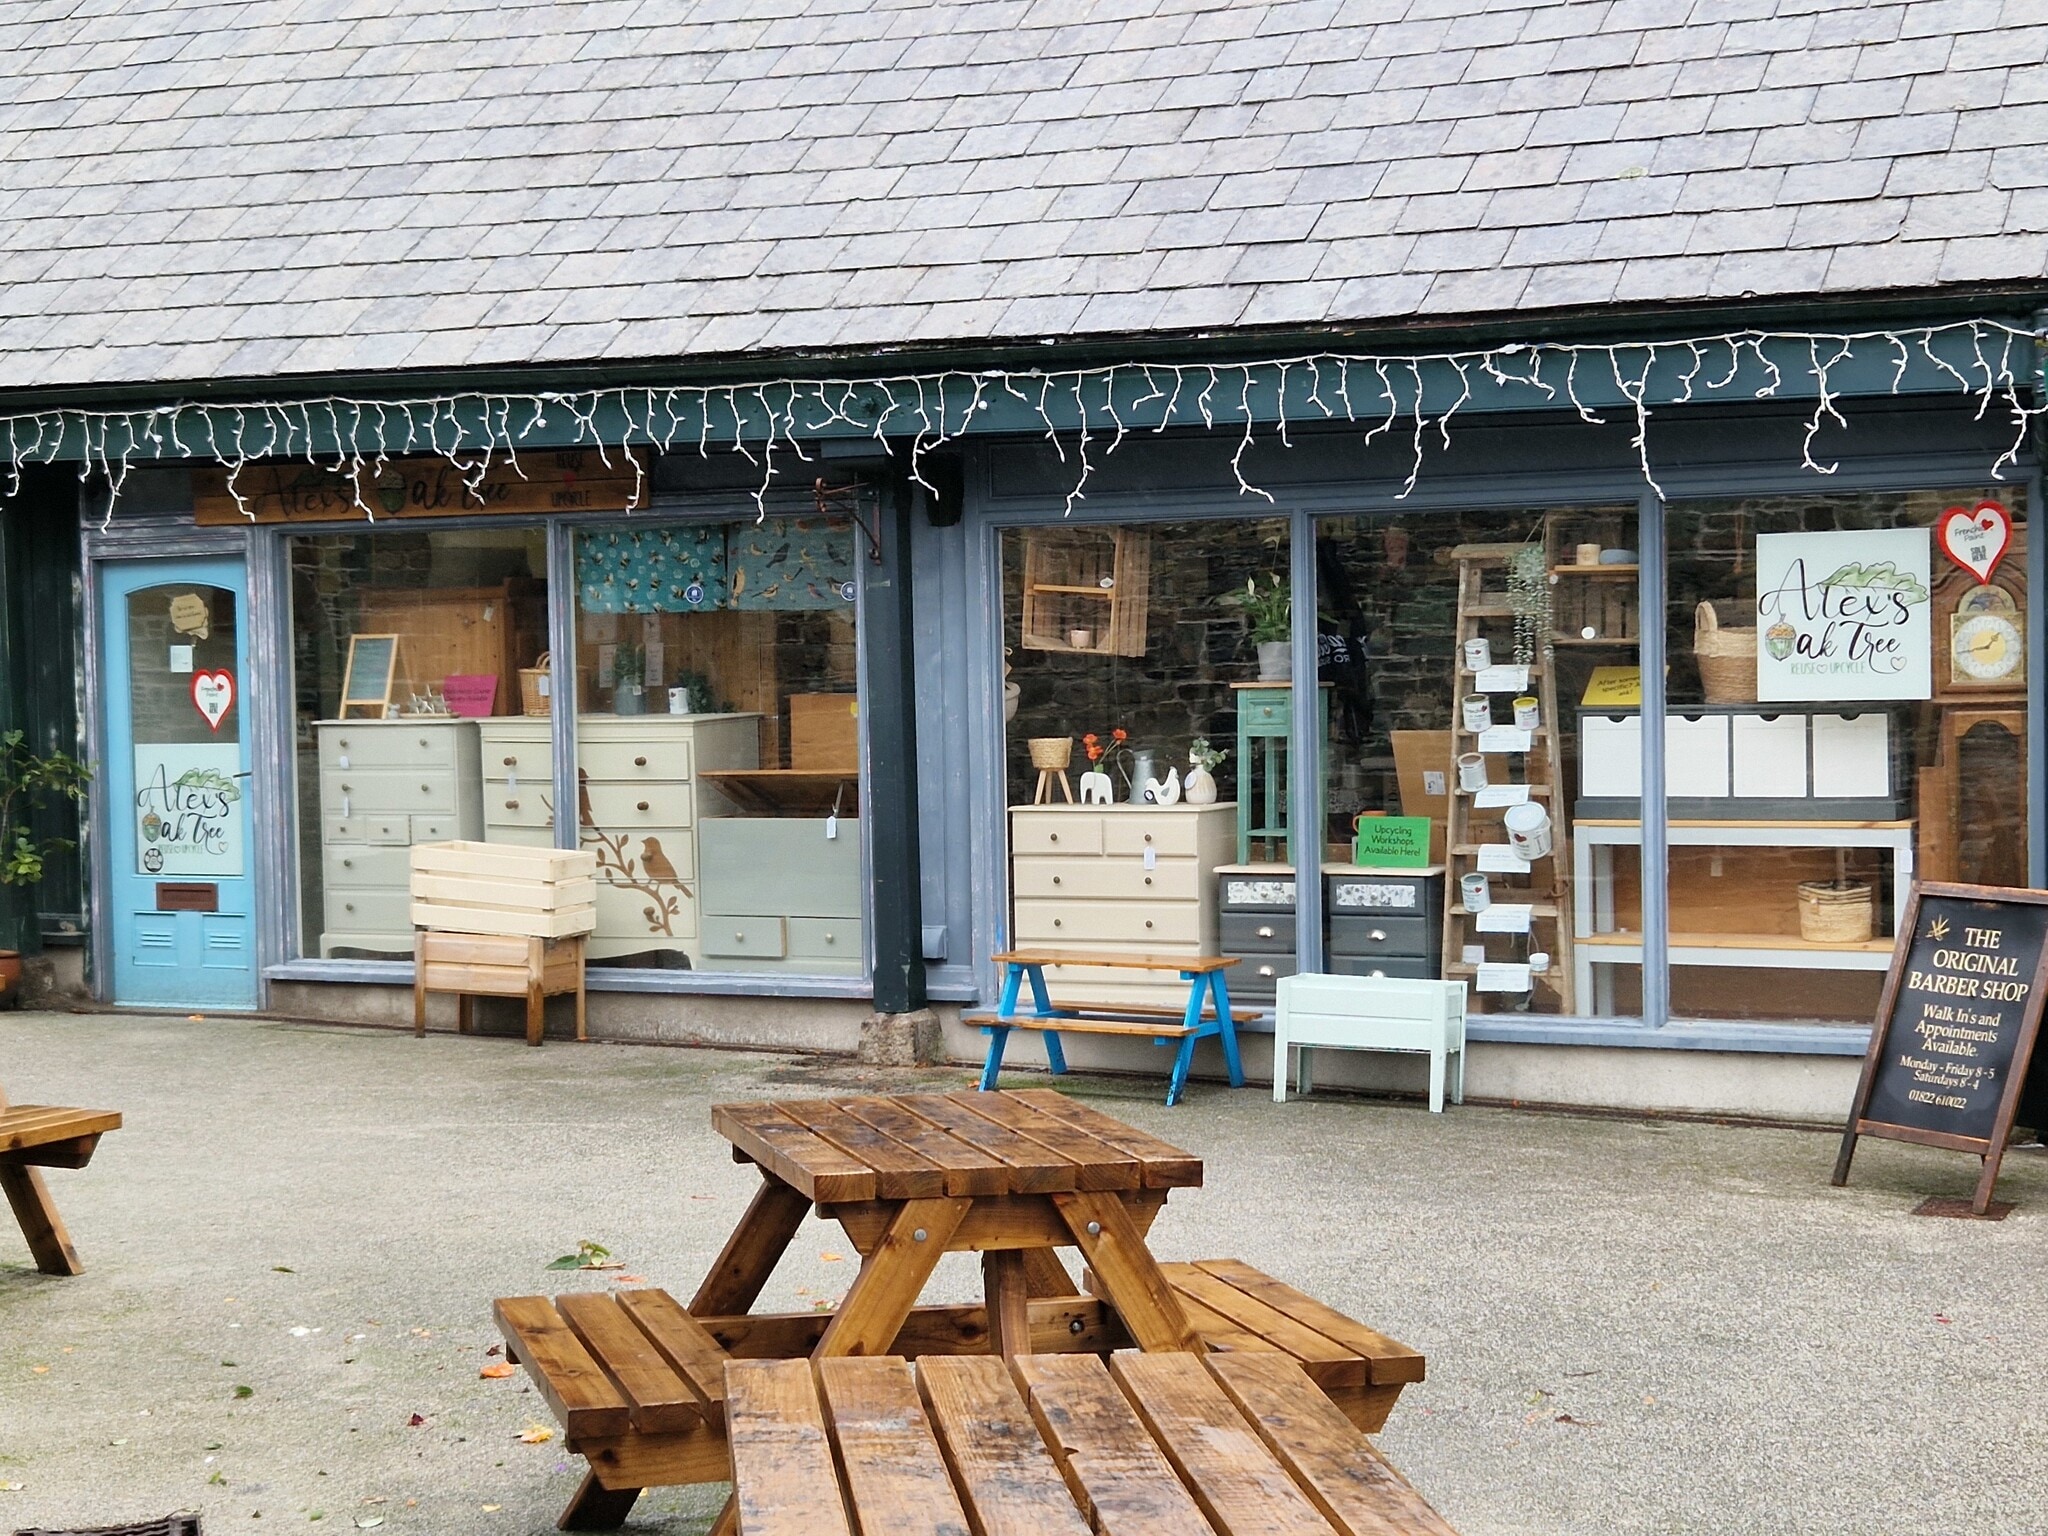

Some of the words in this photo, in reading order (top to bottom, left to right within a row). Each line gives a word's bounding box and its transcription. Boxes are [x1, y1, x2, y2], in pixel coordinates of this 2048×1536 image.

[1758, 558, 1910, 625] Alex's
[1839, 621, 1902, 666] Tree
[1790, 661, 1816, 674] REUSE
[1829, 661, 1866, 674] UPCYCLE
[137, 763, 230, 818] Alex's
[187, 812, 225, 847] Tree
[1371, 835, 1415, 846] Workshops
[1374, 825, 1412, 837] Upcycling
[1363, 846, 1399, 856] Available
[1400, 848, 1421, 857] Here!
[1965, 927, 2002, 949] THE
[1933, 949, 2019, 977] ORIGINAL
[1908, 971, 1979, 997] BARBER
[1981, 980, 2029, 1002] SHOP
[1923, 1003, 1954, 1021] Walk
[1956, 1008, 1977, 1024] In's
[1978, 1013, 2002, 1027] and
[1914, 1019, 1999, 1043] Appointments
[1921, 1038, 1978, 1057] Available.
[1900, 1055, 1939, 1074] Monday
[1945, 1062, 1974, 1080] Friday
[1975, 1067, 1983, 1078] 8
[1988, 1068, 1995, 1079] 5
[1913, 1070, 1959, 1089] Saturdays
[1960, 1077, 1967, 1088] 8
[1972, 1080, 1979, 1090] 4
[1908, 1089, 1936, 1104] 01822
[1935, 1095, 1967, 1109] 610022
